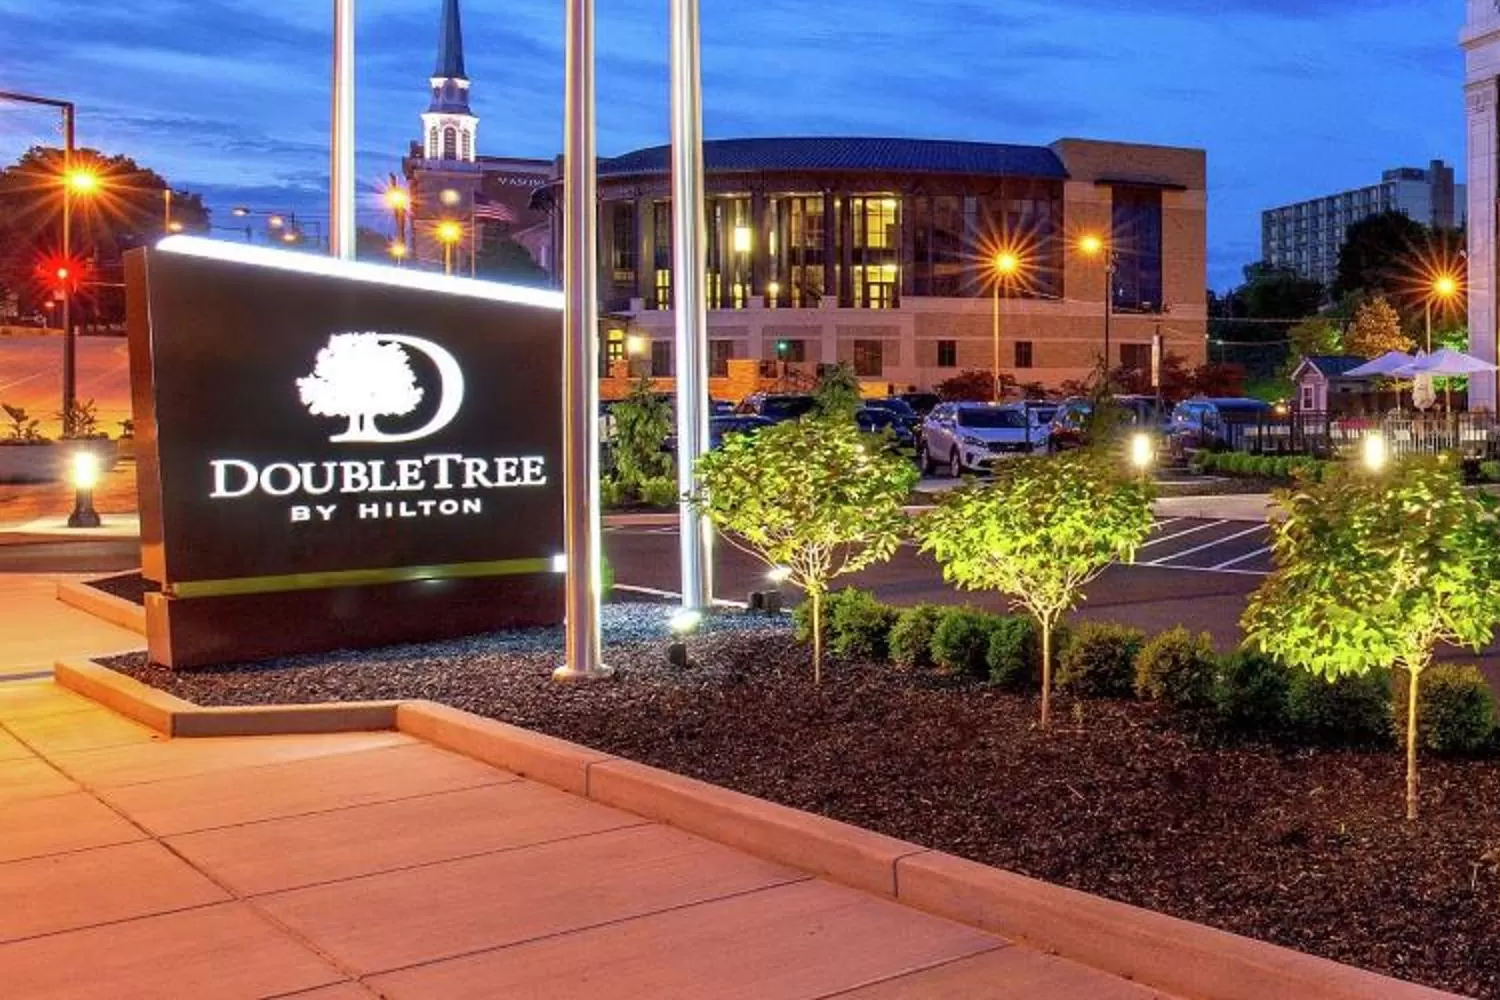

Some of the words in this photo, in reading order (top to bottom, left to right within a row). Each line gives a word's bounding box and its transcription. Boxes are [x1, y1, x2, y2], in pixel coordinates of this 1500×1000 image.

[209, 453, 547, 498] DOUBLETREE
[290, 504, 337, 522] BY
[358, 497, 482, 519] HILTON
